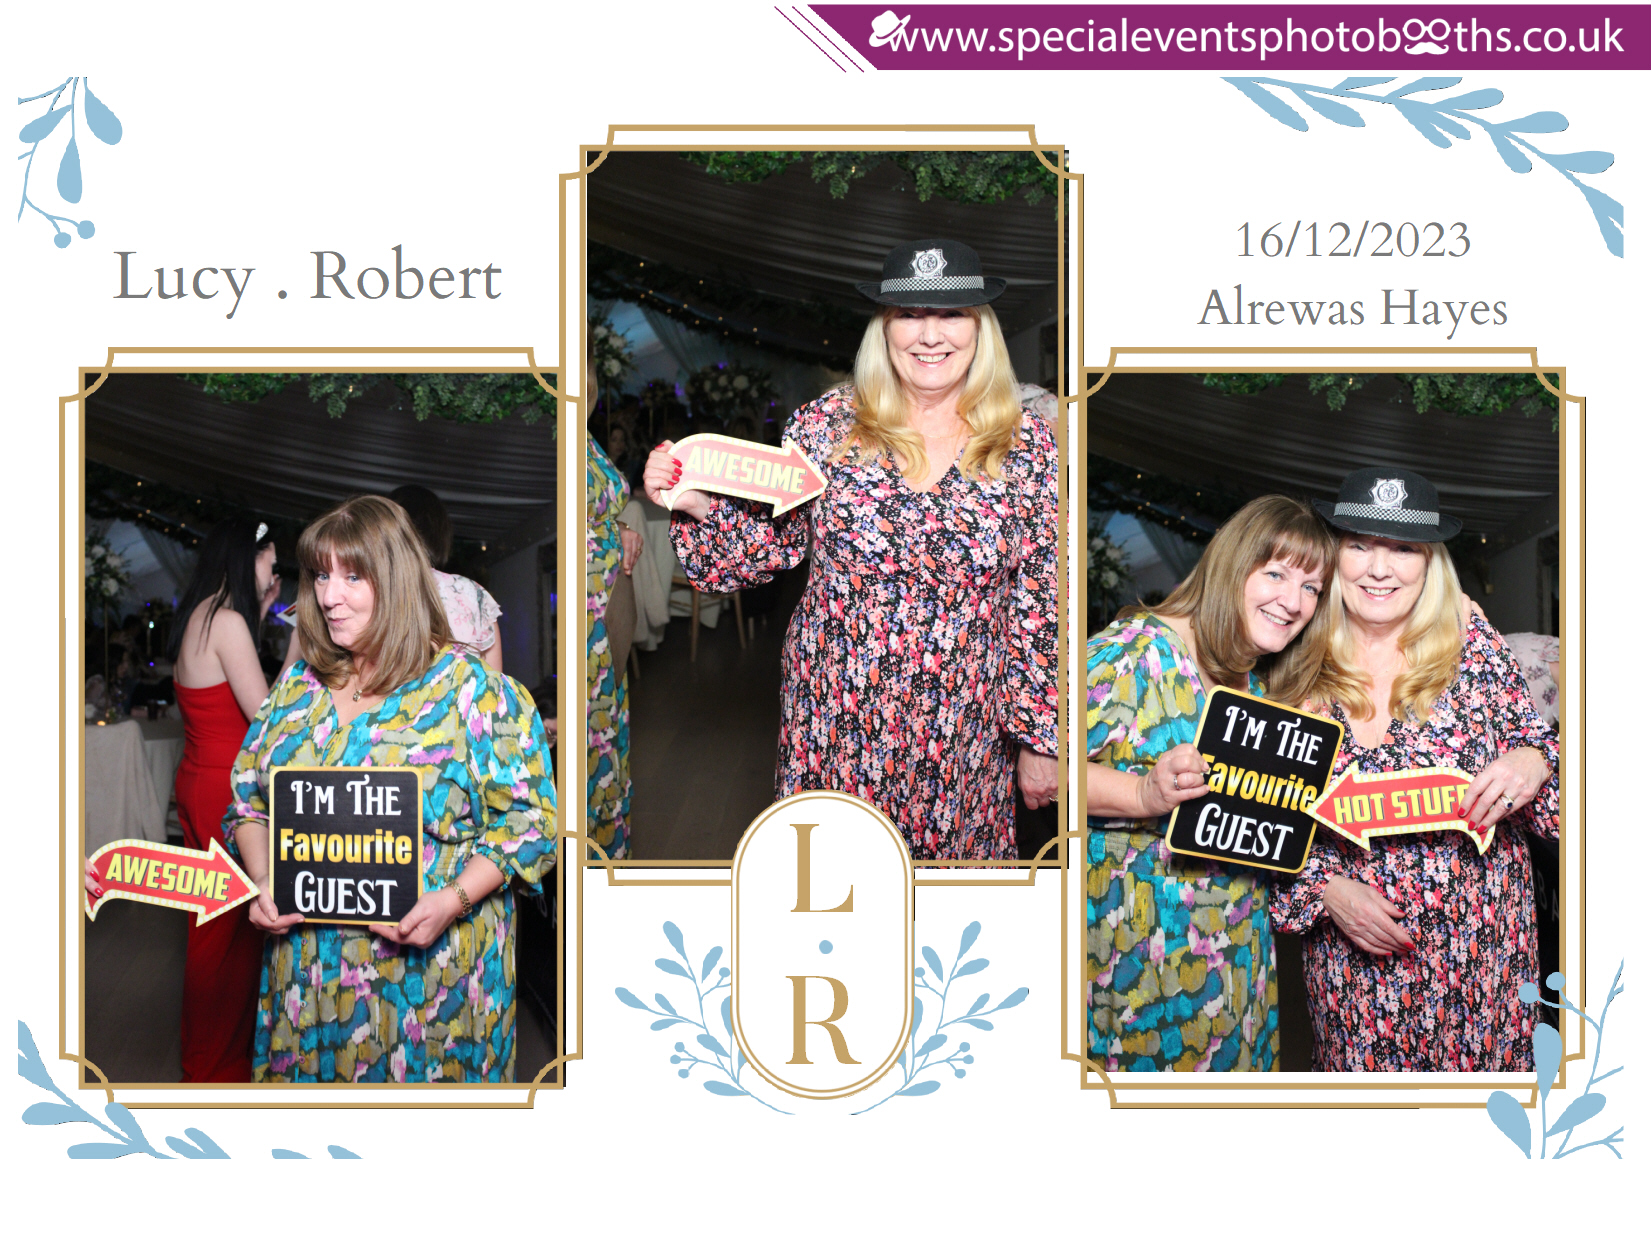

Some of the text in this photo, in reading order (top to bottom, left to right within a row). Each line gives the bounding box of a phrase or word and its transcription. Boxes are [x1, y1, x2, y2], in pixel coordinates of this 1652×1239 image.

[684, 445, 806, 494] AWESOME
[1222, 705, 1323, 766] I'M THE
[291, 775, 401, 816] I'M THE
[1333, 793, 1385, 824] HOT
[280, 828, 412, 865] Favourite
[1194, 803, 1294, 860] GUEST
[105, 853, 232, 902] AWESOME
[295, 871, 398, 916] GUEST
